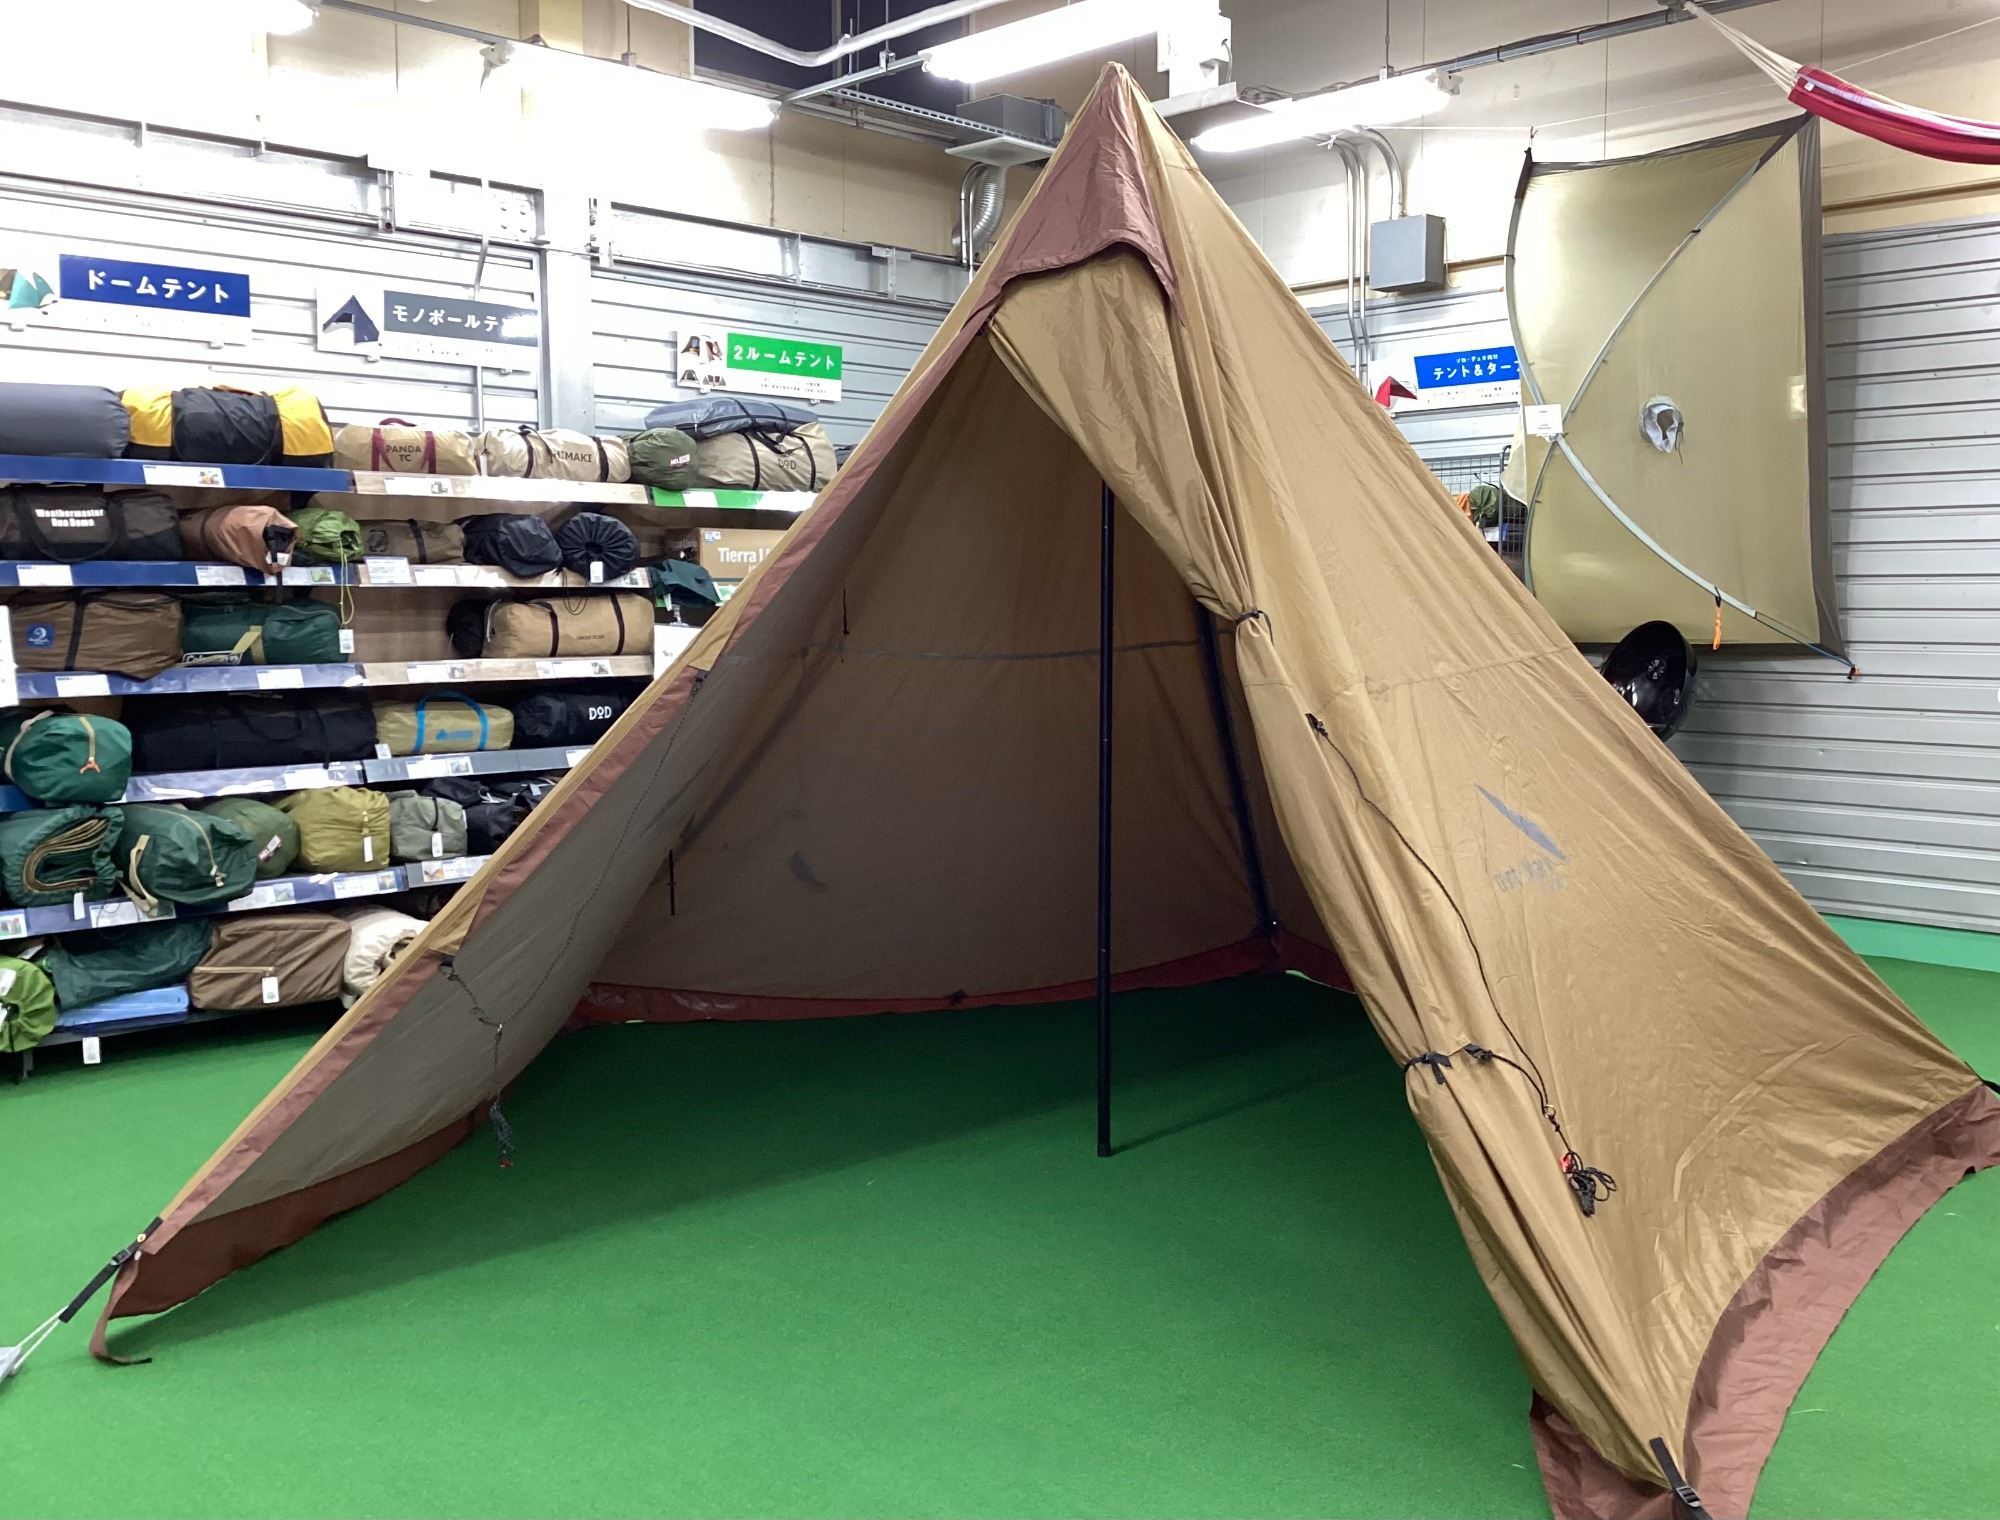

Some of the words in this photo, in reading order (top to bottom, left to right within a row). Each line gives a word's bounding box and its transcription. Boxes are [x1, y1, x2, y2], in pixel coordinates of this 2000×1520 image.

[88, 269, 229, 304] ドームテント
[392, 305, 499, 332] モノポールテ
[733, 344, 835, 370] 2ルームテント
[386, 445, 422, 453] PANDA
[398, 454, 411, 462] TC
[718, 547, 757, 563] Tierra
[588, 705, 612, 721] DOD
